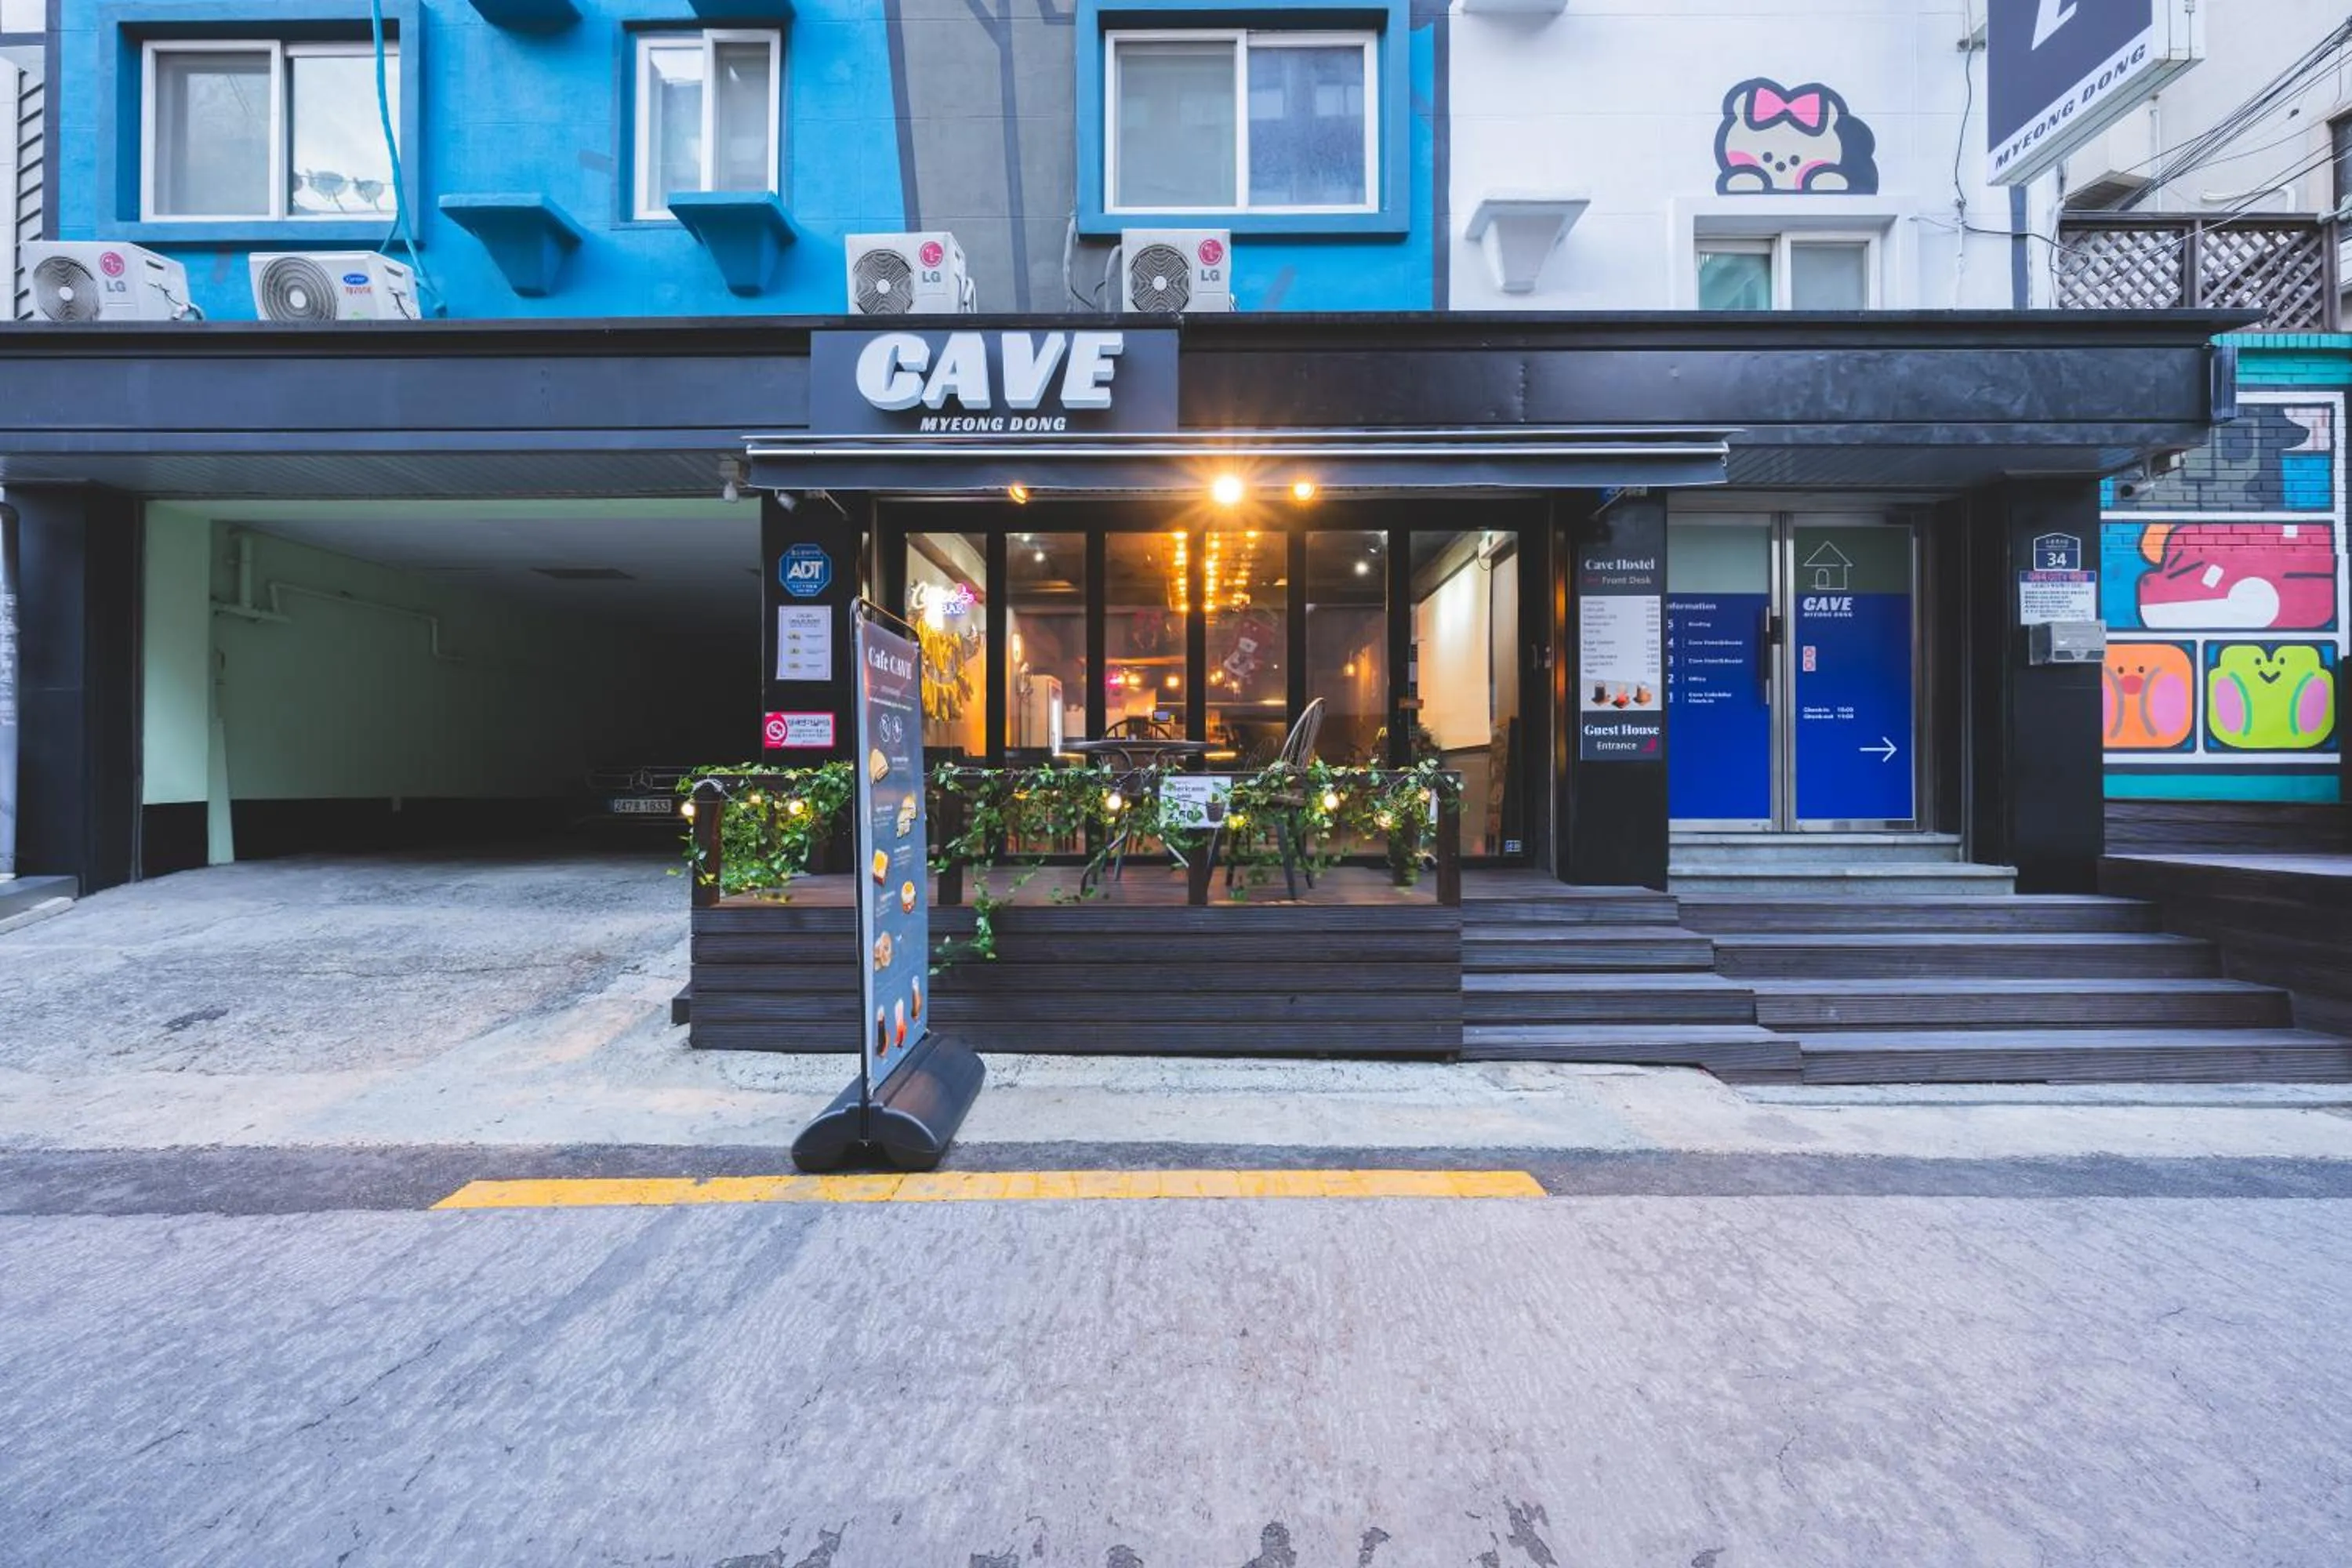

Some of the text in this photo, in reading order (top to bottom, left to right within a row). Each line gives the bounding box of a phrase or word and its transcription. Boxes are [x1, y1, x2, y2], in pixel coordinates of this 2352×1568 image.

[1994, 43, 2147, 170] MYEONG DONG
[922, 270, 941, 283] LG
[1200, 269, 1220, 281] LG
[106, 280, 126, 293] LG
[856, 332, 1123, 410] CAVE
[920, 416, 1067, 432] MYEONG DONG
[1584, 558, 1655, 571] Cave Hostel
[2047, 552, 2067, 567] 34
[788, 561, 823, 579] ADT
[1602, 575, 1651, 584] Front Desk
[1666, 602, 1716, 611] nformation
[1802, 597, 1853, 611] CAVE
[1668, 619, 1674, 629] 5
[1668, 637, 1675, 648] 4
[868, 646, 913, 681] Cafe CAVE
[1668, 655, 1674, 666] 3
[1668, 673, 1675, 684] 2
[1668, 692, 1674, 703] 1
[1584, 724, 1660, 736] Guest House
[1596, 741, 1637, 750] Entrance
